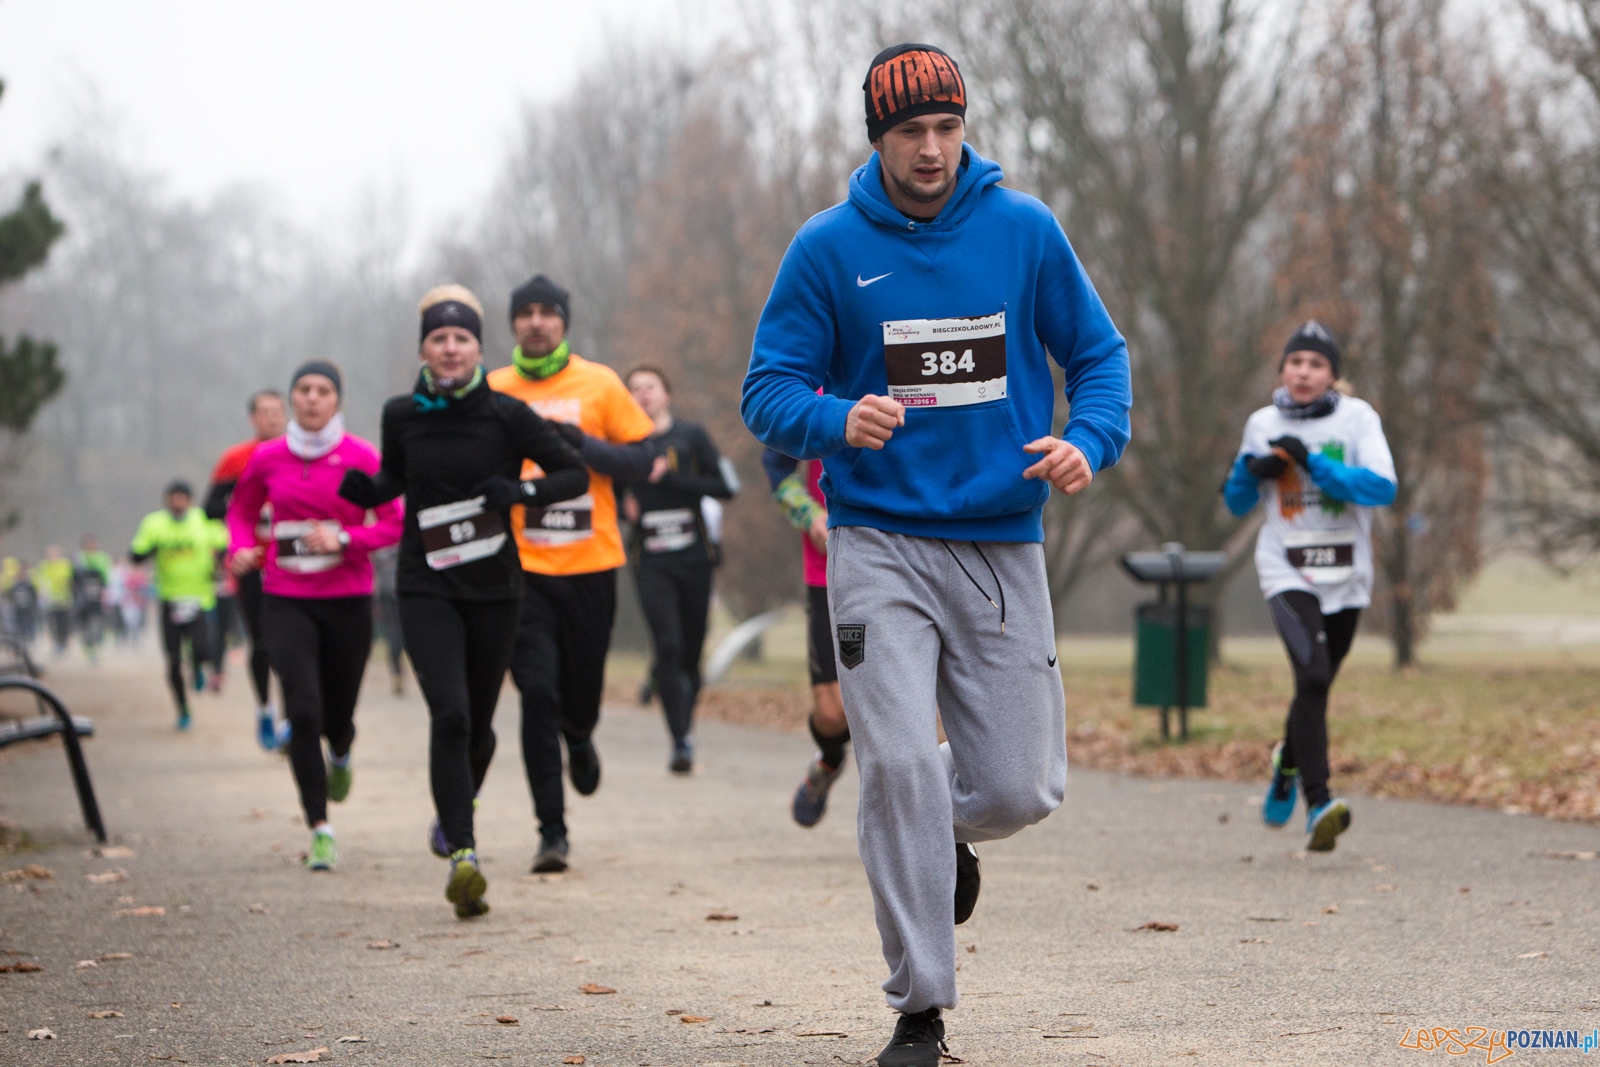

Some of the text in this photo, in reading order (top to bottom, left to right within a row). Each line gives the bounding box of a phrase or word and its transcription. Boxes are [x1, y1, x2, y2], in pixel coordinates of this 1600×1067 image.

[932, 322, 1001, 334] BIEGCZEKOLADOWY.PL
[921, 349, 975, 376] 384
[449, 520, 476, 544] 89
[839, 629, 862, 641] NIKE
